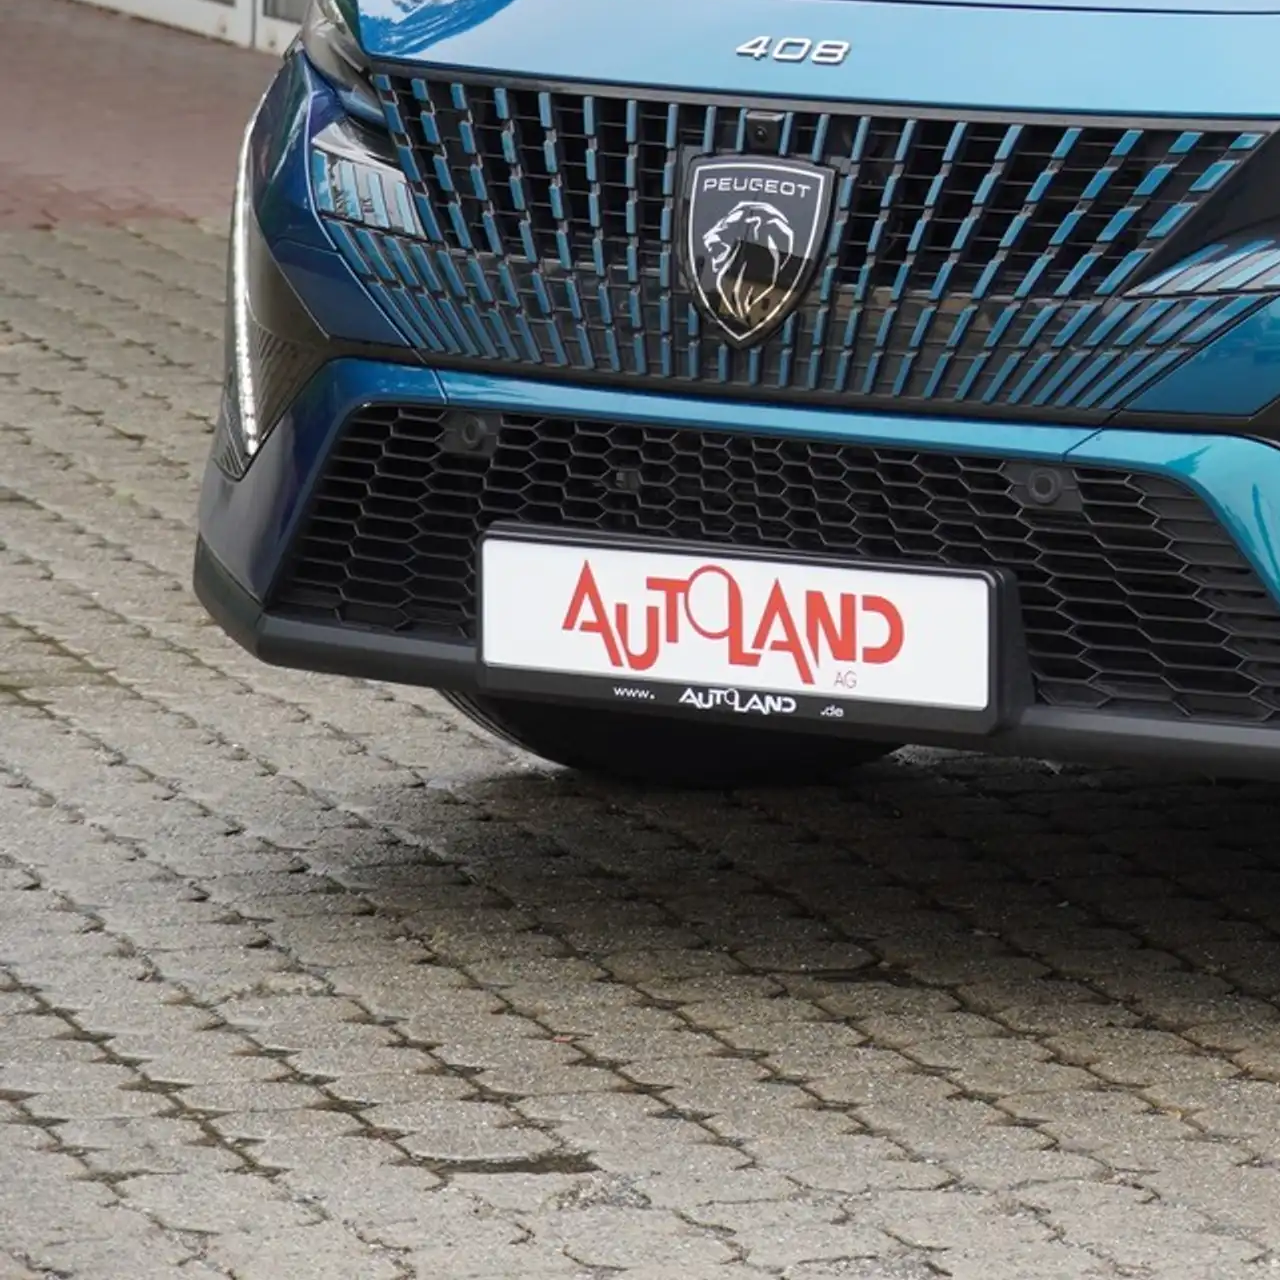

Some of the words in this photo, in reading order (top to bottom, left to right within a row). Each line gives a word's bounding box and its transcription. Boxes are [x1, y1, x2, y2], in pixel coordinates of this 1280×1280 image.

[735, 34, 853, 65] 408
[702, 176, 813, 199] PEUGEOT
[561, 558, 906, 685] AUTOLAND
[833, 670, 858, 690] AG
[612, 686, 657, 701] www.
[678, 686, 797, 716] AUTOLAND
[820, 703, 845, 719] .de
